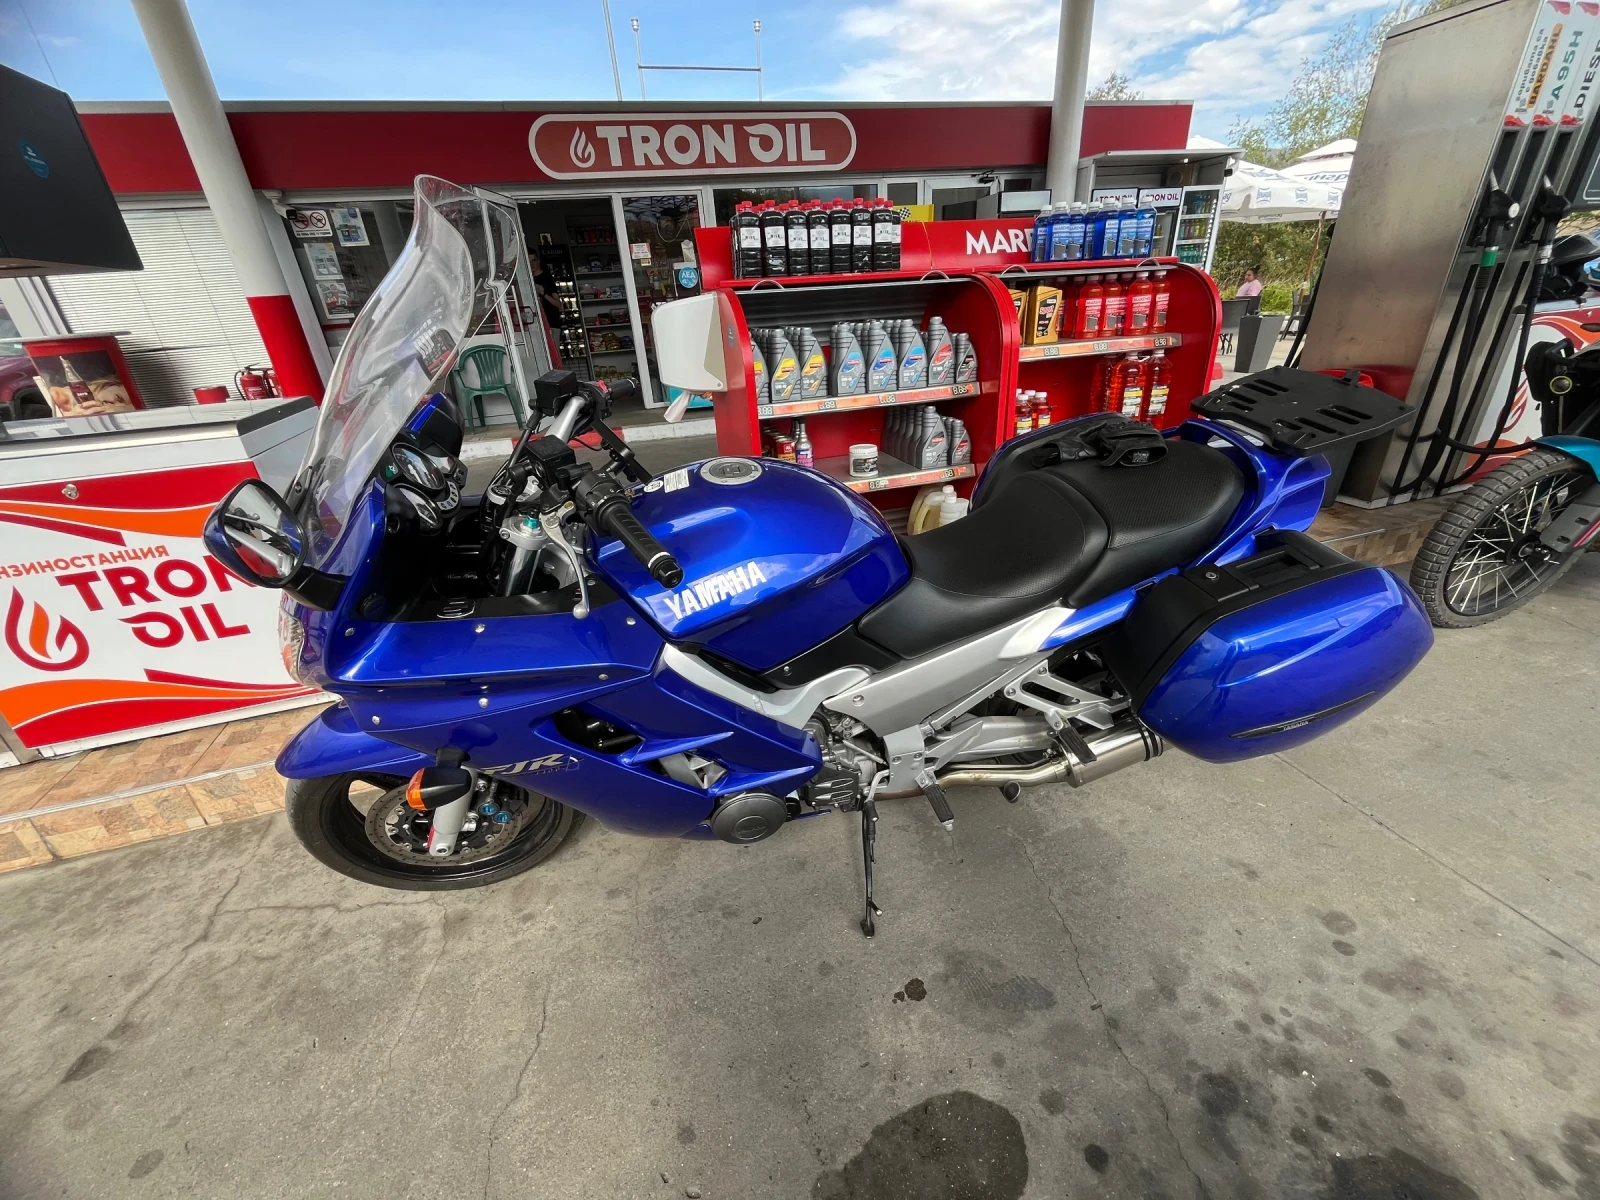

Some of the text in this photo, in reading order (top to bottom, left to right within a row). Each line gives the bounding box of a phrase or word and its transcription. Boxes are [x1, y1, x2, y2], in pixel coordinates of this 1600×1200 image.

[1528, 27, 1563, 105] BARDAHL
[596, 123, 826, 167] TRON OIL
[664, 561, 767, 621] YAMAHA
[118, 602, 251, 648] OIL
